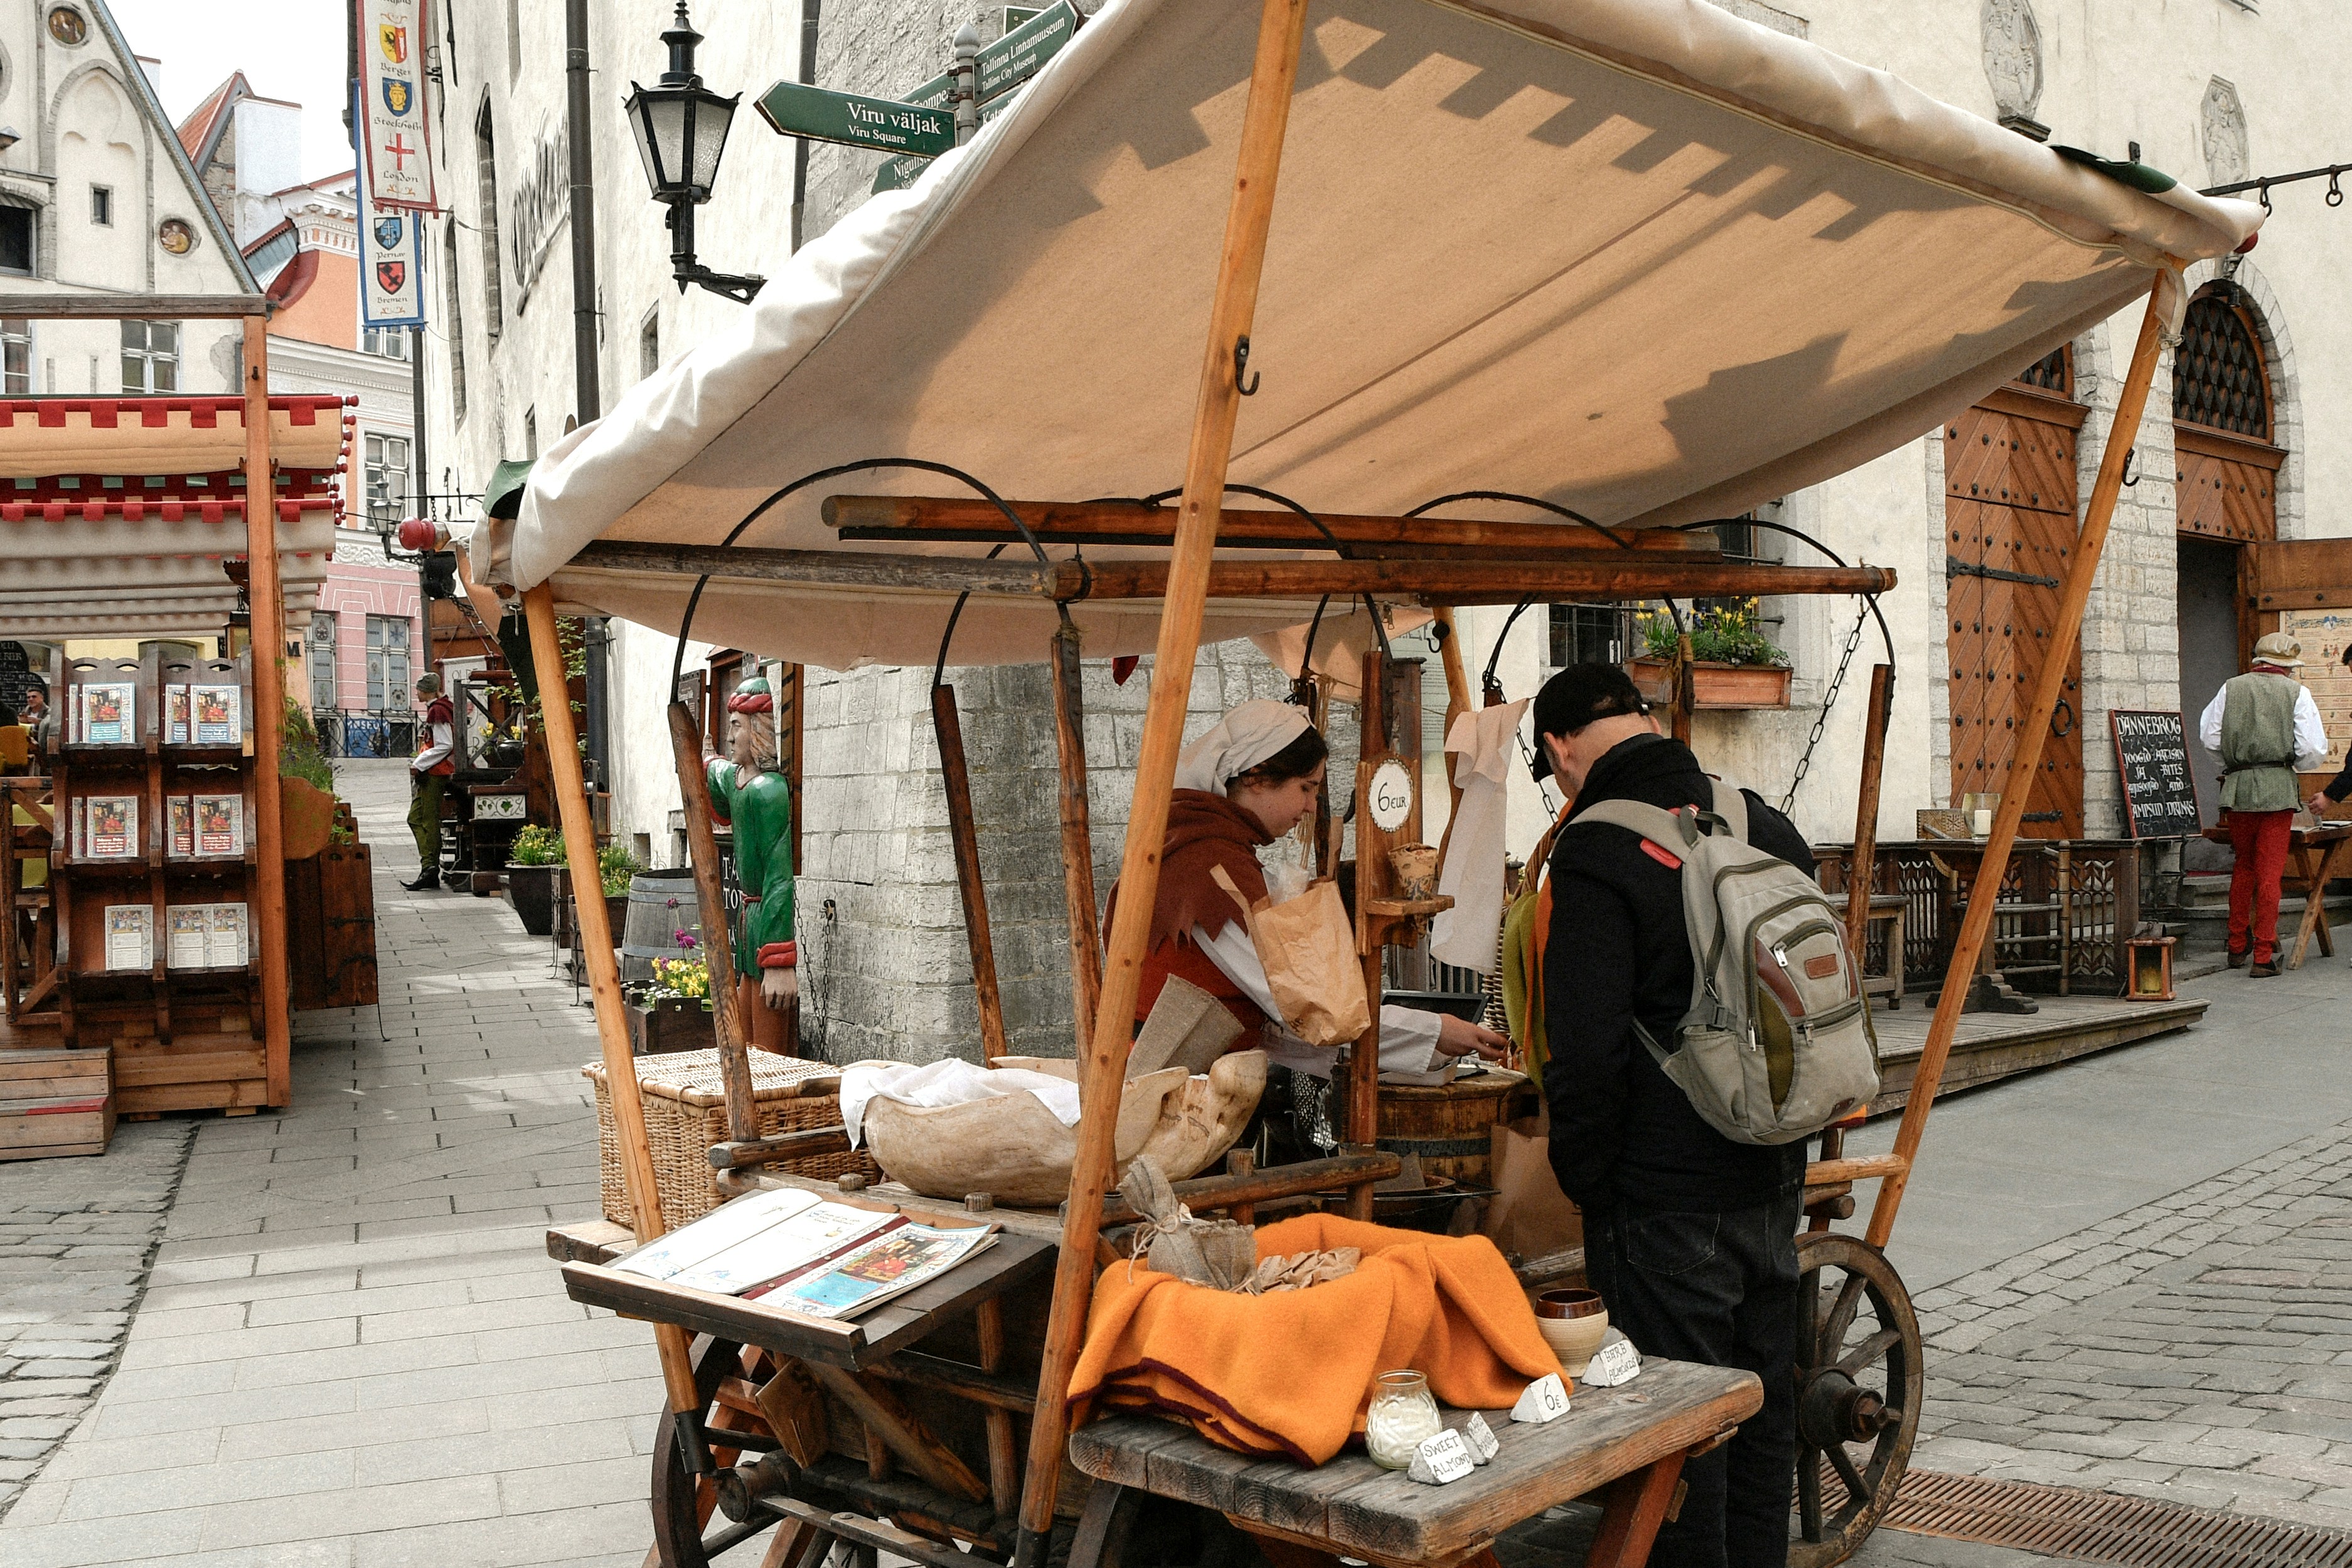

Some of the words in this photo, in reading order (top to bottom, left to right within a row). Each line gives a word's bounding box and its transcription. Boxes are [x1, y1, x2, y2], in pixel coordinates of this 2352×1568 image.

[981, 50, 1010, 77] Tallinna
[1010, 16, 1065, 60] Linnamuuseum
[981, 77, 1000, 92] Tallinn
[1000, 68, 1013, 82] City
[1013, 53, 1037, 74] Museum
[847, 102, 885, 125] Viru
[889, 111, 942, 136] väljak
[848, 124, 870, 139] Viru
[872, 128, 907, 144] Square
[383, 170, 419, 183] London
[2115, 715, 2181, 737] DANNEBROG
[2135, 765, 2147, 780] JA
[2160, 763, 2183, 777] BITES
[1378, 782, 1390, 811] 6
[1391, 796, 1407, 809] EUR
[2132, 803, 2163, 819] AMPSUD
[2166, 799, 2195, 818] DRINKS
[1603, 1343, 1627, 1363] HERB
[1608, 1357, 1637, 1381] ALMONDS
[1544, 1380, 1561, 1411] 6€
[1424, 1435, 1458, 1457] SWEET
[1433, 1453, 1471, 1478] ALMOND
